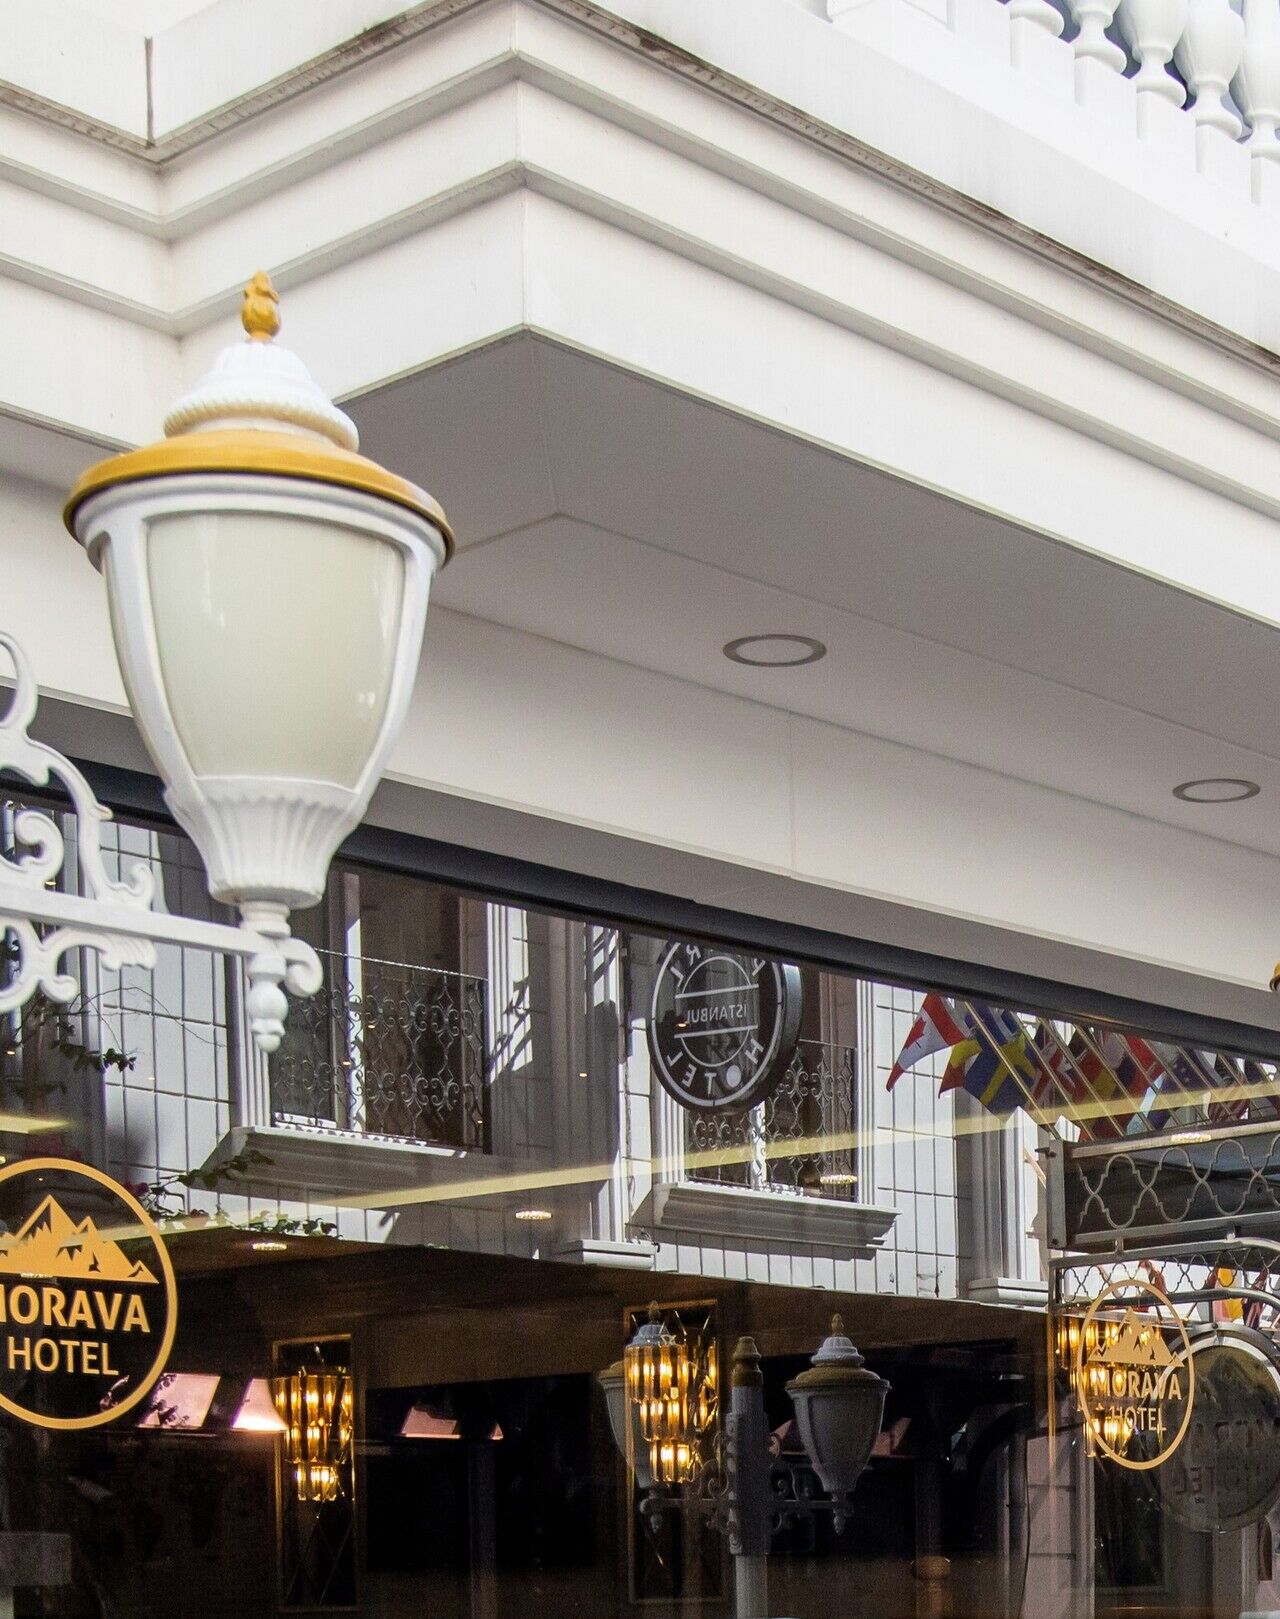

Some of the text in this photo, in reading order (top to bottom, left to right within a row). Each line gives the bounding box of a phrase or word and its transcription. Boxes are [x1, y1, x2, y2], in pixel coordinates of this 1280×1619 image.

[7, 1336, 119, 1376] HOTEL
[1091, 1368, 1182, 1400] MORAVA
[1111, 1405, 1167, 1431] HOTEL
